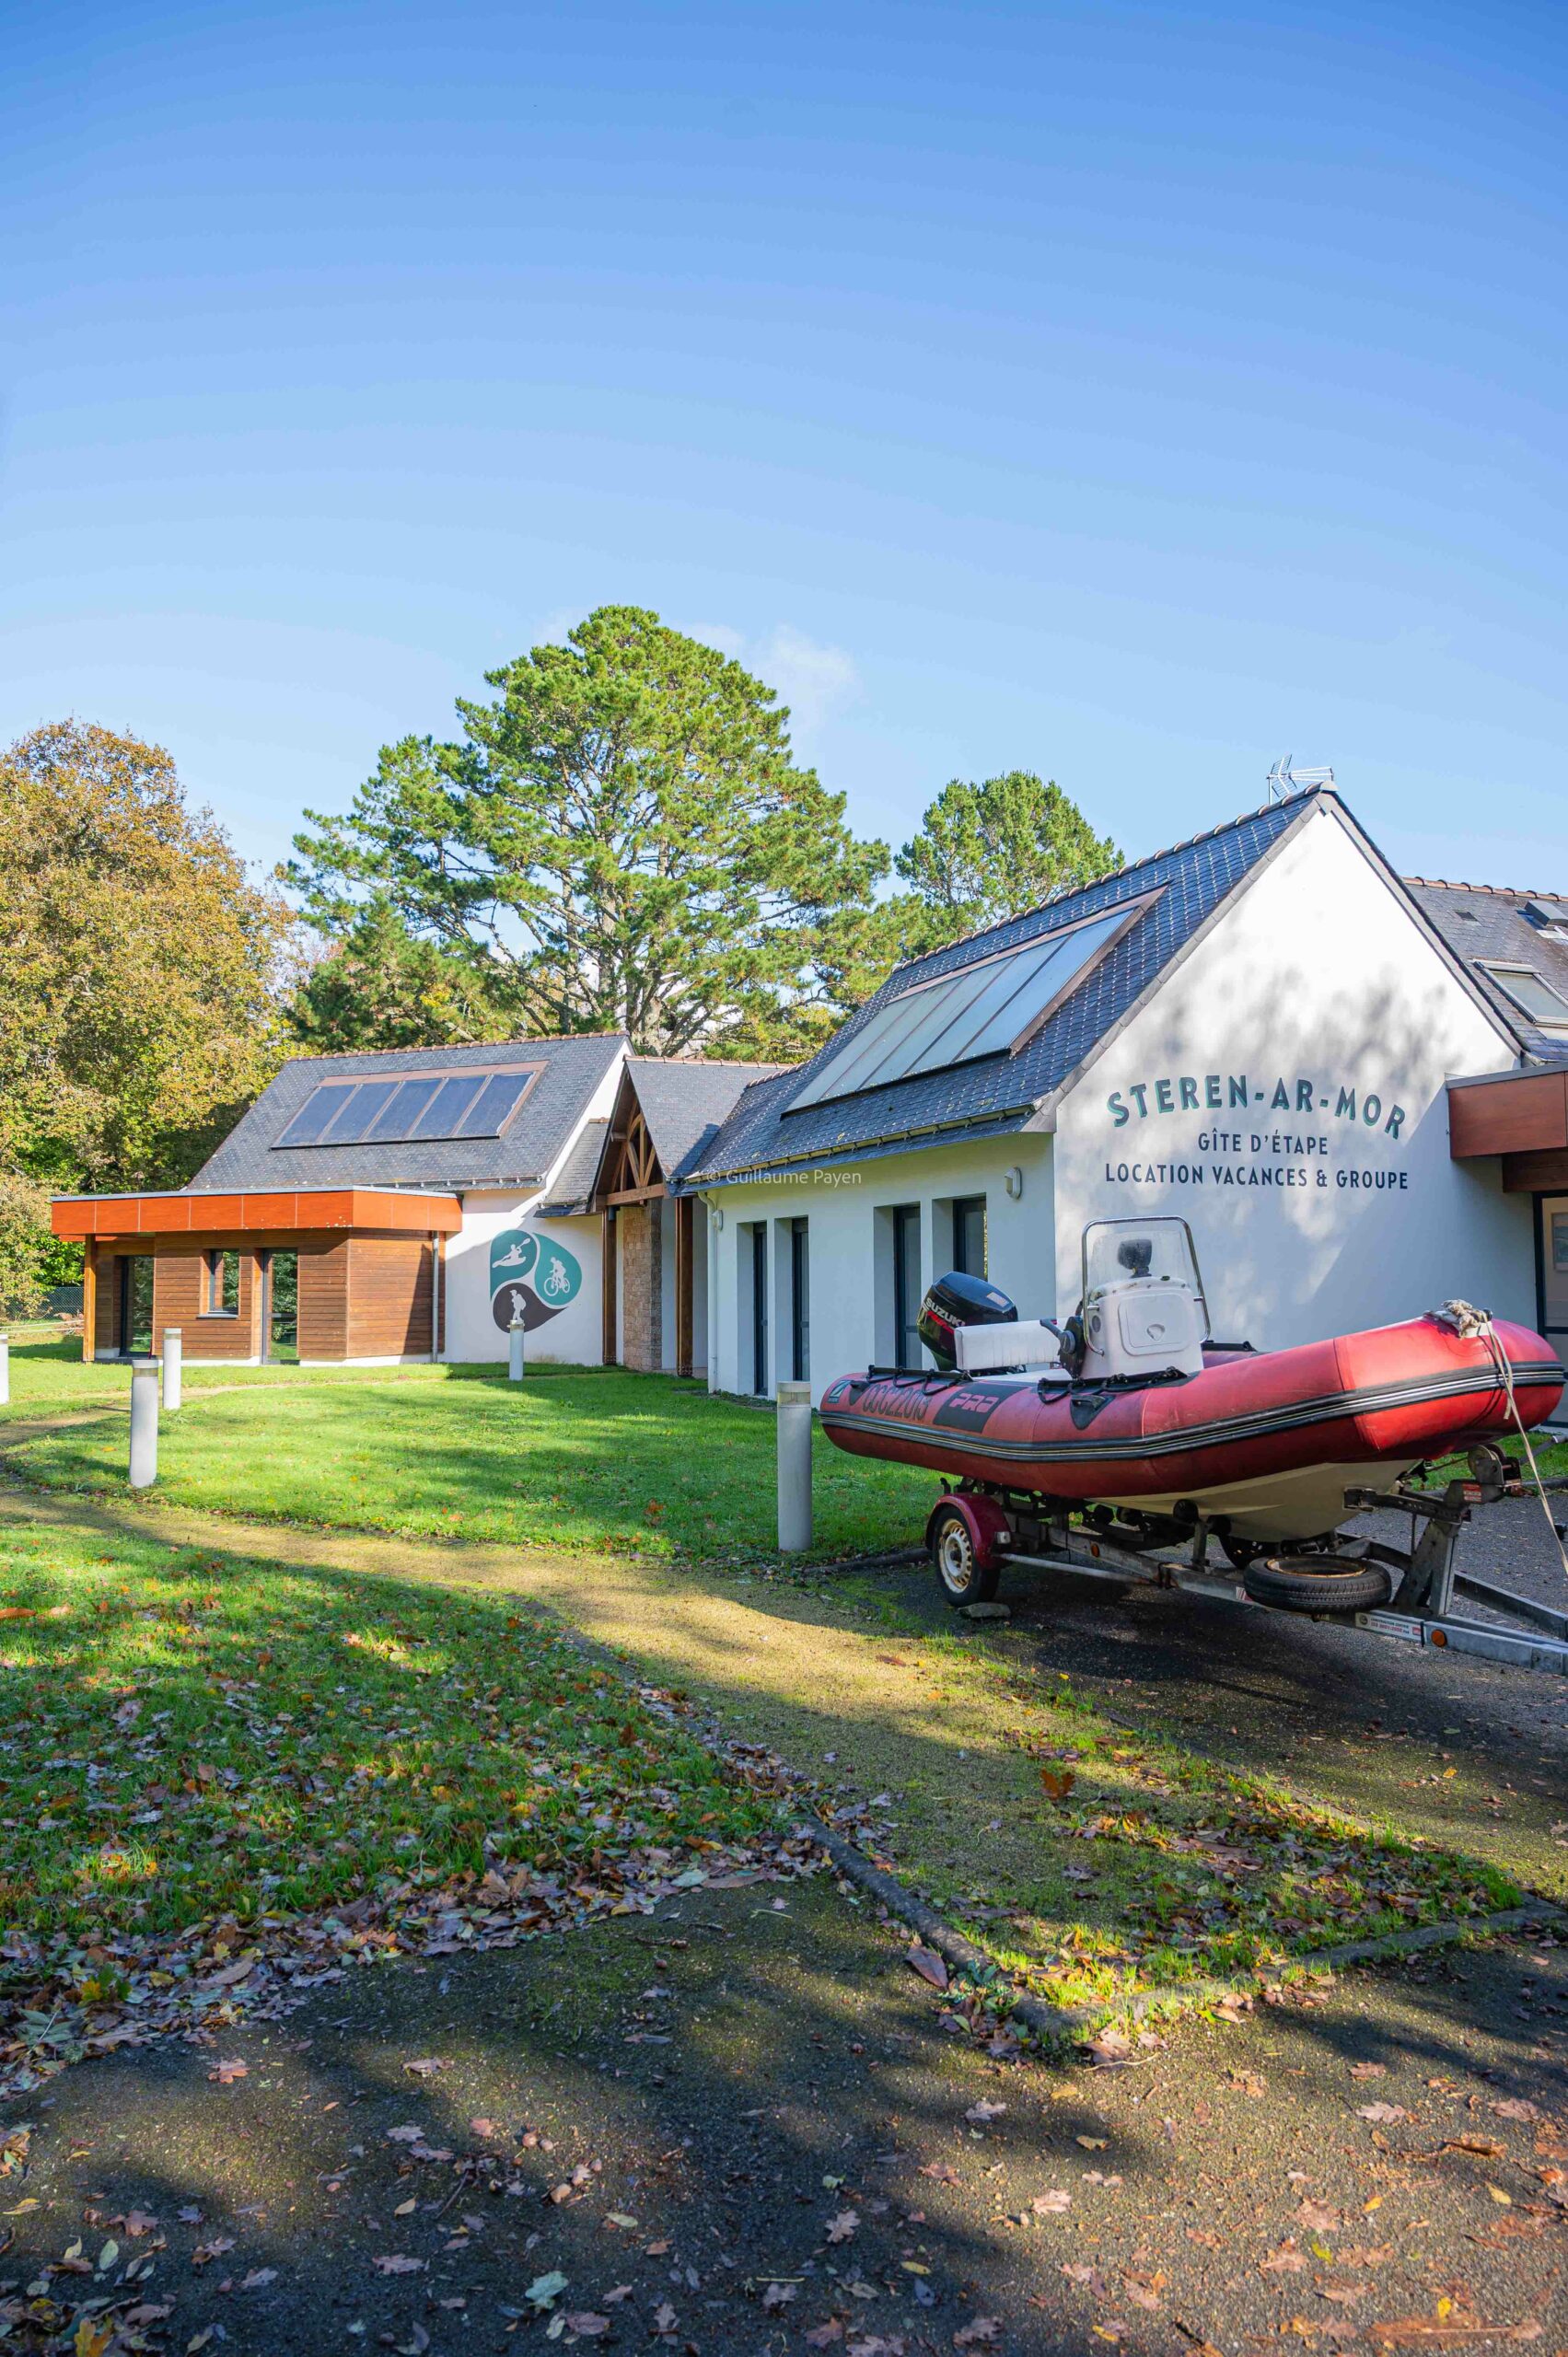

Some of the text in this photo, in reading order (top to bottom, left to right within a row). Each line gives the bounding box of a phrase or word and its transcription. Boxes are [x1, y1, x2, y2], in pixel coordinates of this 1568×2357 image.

[1107, 1074, 1406, 1140] STEREN-AR-MOR
[1198, 1128, 1329, 1155] GÎTE D'ÉTAPE
[1105, 1163, 1409, 1190] LOCATION VACANCES & GROUPE
